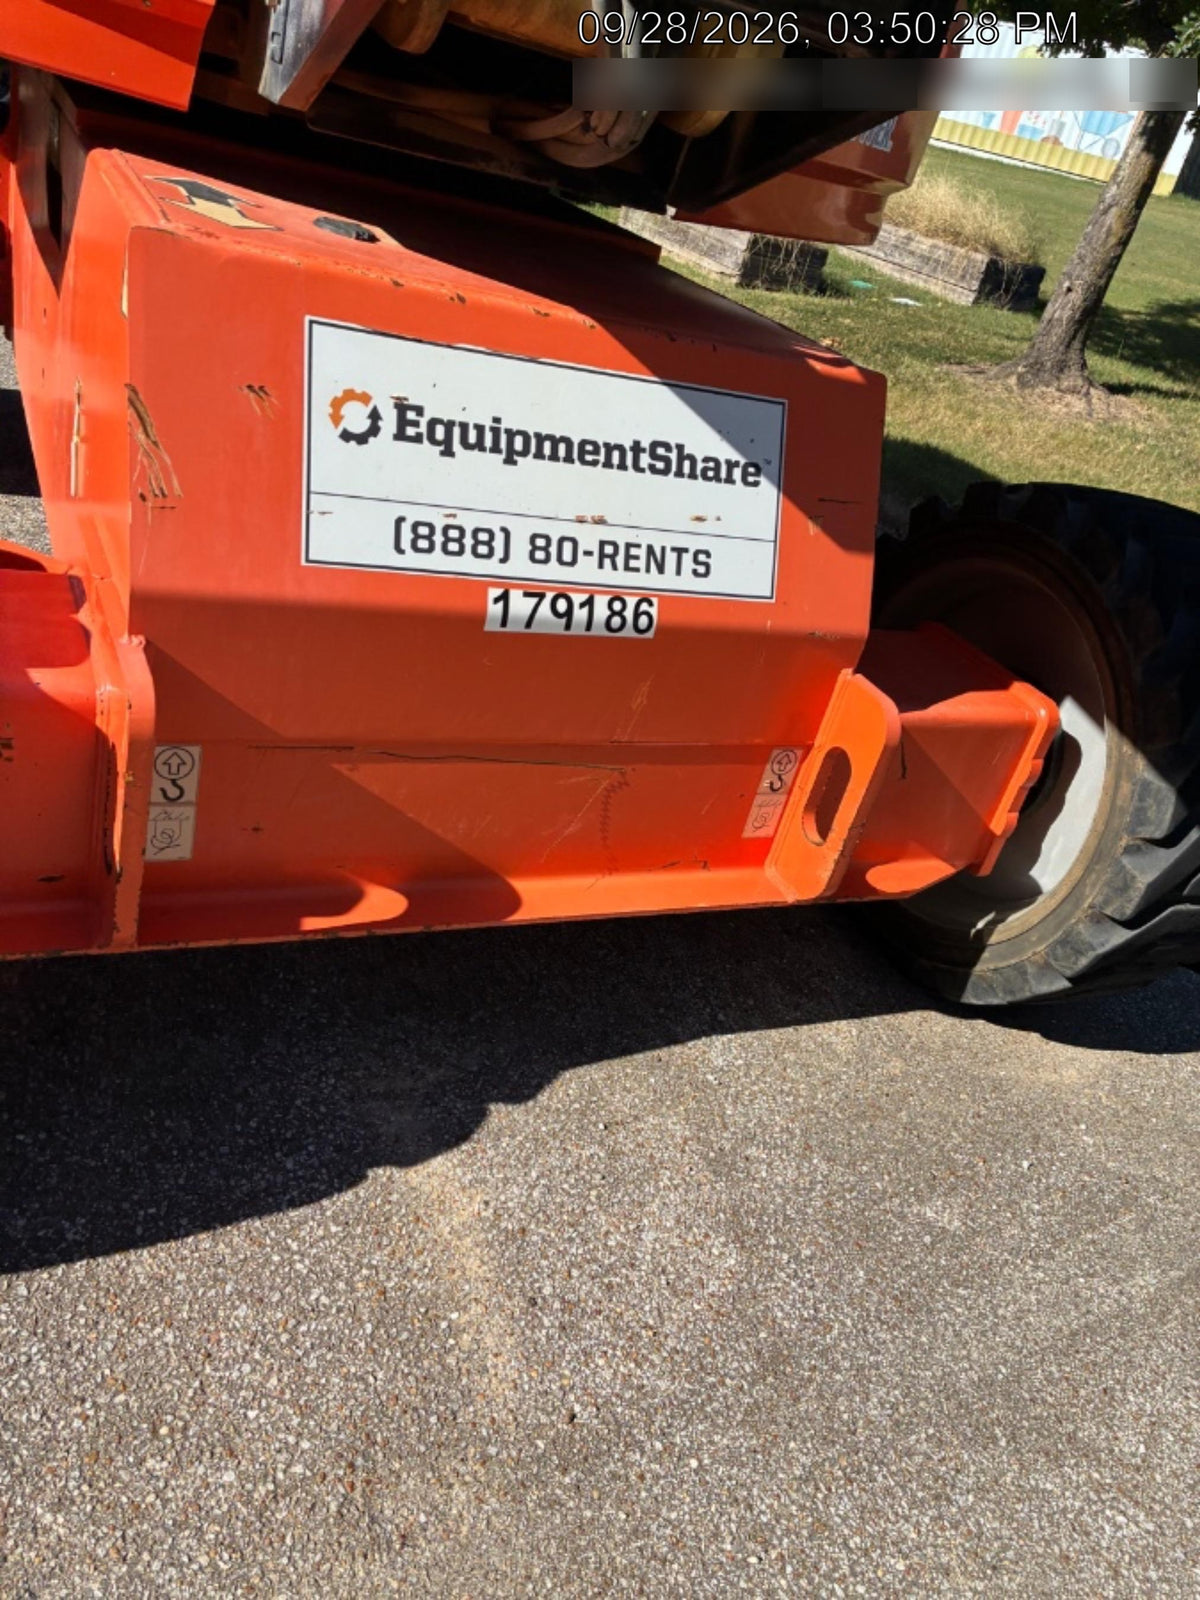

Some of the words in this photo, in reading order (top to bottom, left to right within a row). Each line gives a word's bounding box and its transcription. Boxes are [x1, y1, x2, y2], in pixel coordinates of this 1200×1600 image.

[393, 401, 763, 488] EquipmentShare
[394, 516, 511, 565] (888)
[528, 533, 712, 579] 80-RENTS
[492, 588, 655, 635] 179186
